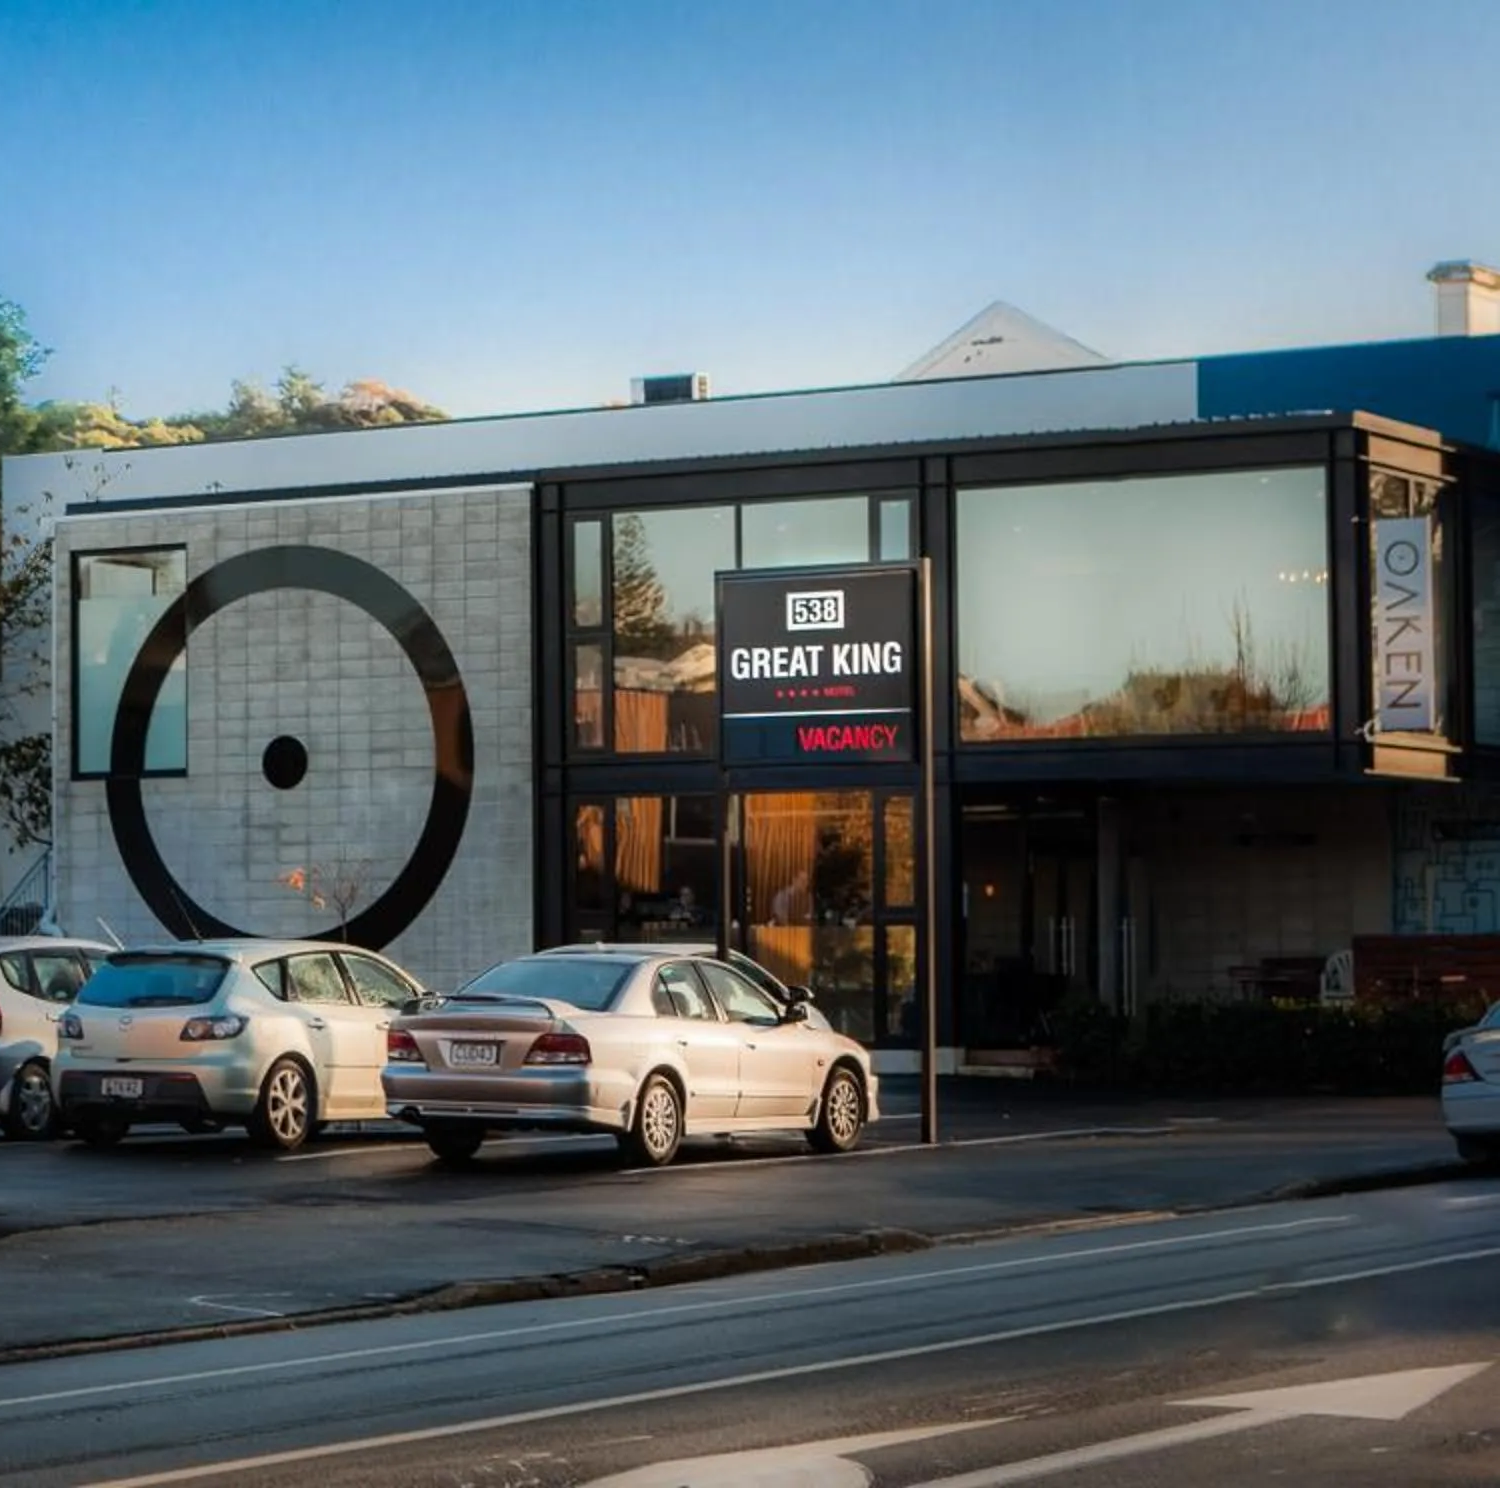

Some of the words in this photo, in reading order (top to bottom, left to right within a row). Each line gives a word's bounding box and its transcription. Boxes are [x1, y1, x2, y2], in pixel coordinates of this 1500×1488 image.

[795, 599, 837, 623] 538
[731, 645, 824, 680] GREAT
[832, 641, 902, 675] KING
[797, 724, 899, 752] VACANCY
